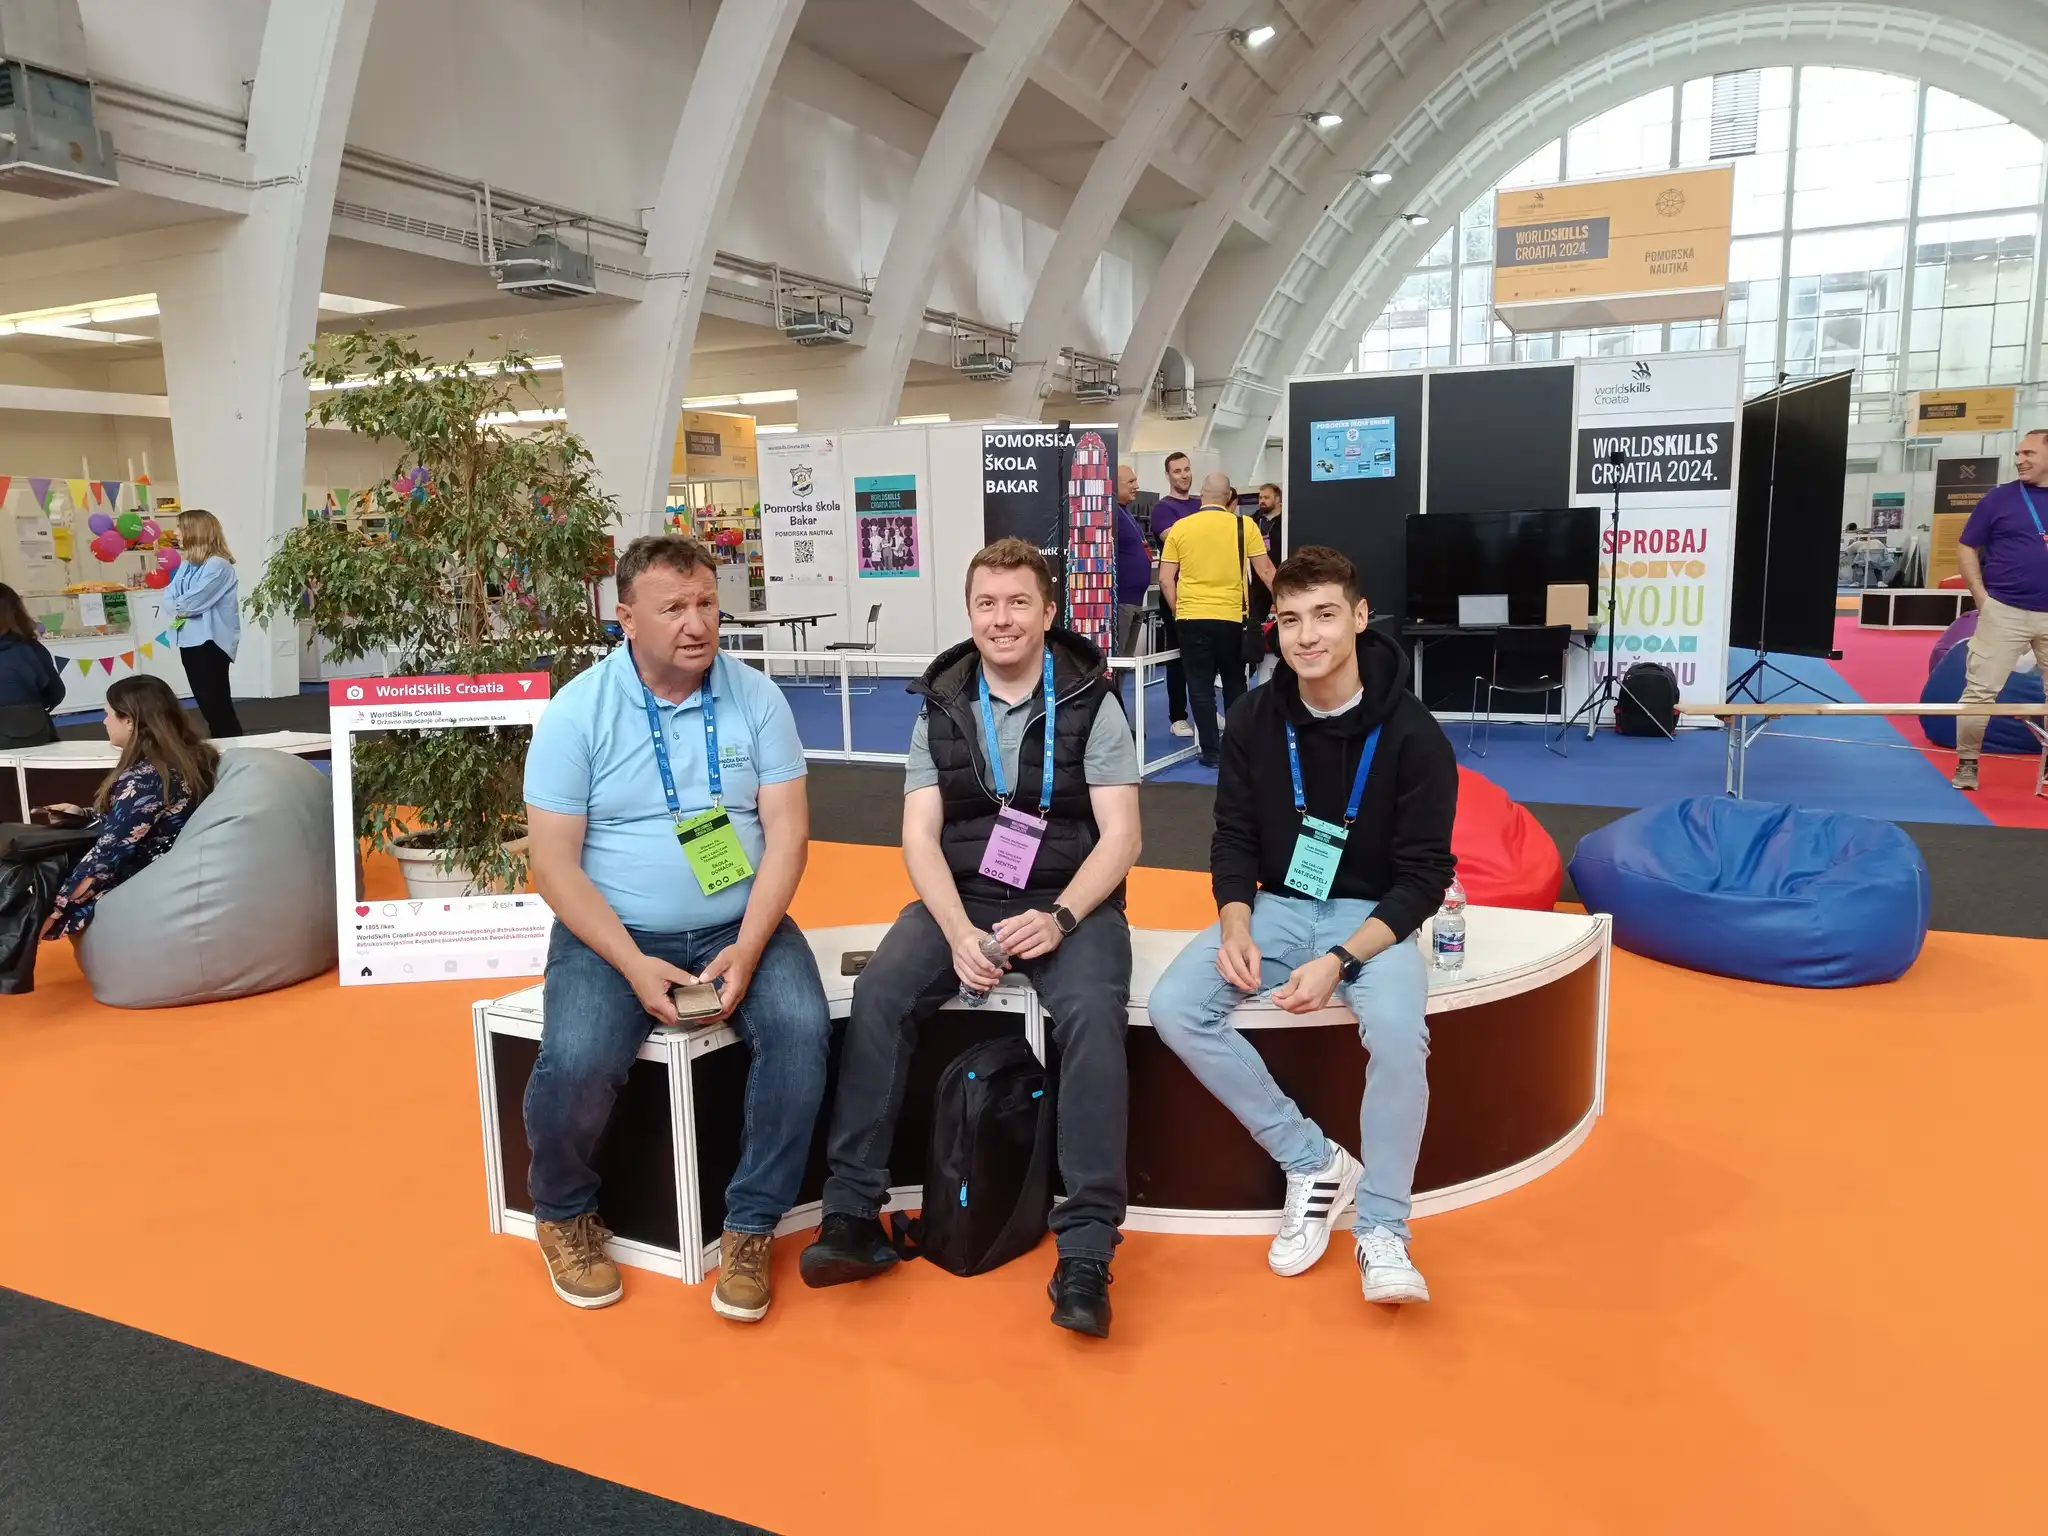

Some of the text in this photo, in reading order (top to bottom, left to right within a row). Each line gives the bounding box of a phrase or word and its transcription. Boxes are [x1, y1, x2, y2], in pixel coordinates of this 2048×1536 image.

[1515, 225, 1589, 245] WORLDSKILLS
[1515, 242, 1589, 260] CROATIA 2024.
[1644, 247, 1695, 262] POMORSKA
[1650, 261, 1688, 275] NAUTIKA
[1595, 382, 1651, 395] worldskills
[1594, 395, 1629, 405] Croatia
[985, 433, 1076, 448] POMORSKA
[1593, 433, 1719, 458] WORLDSKILLS
[985, 454, 1037, 471] ŠKOLA
[1591, 461, 1662, 484] CROATIA
[1666, 459, 1718, 482] 2024.
[986, 480, 1039, 493] BAKAR
[764, 500, 840, 513] Pomorska škola
[790, 515, 817, 525] Bakar
[1593, 585, 1704, 626] SVOJU
[375, 682, 504, 696] WorldSkills Croatia
[994, 859, 1018, 871] MENTOR
[1293, 867, 1328, 885] NATJECATELJ
